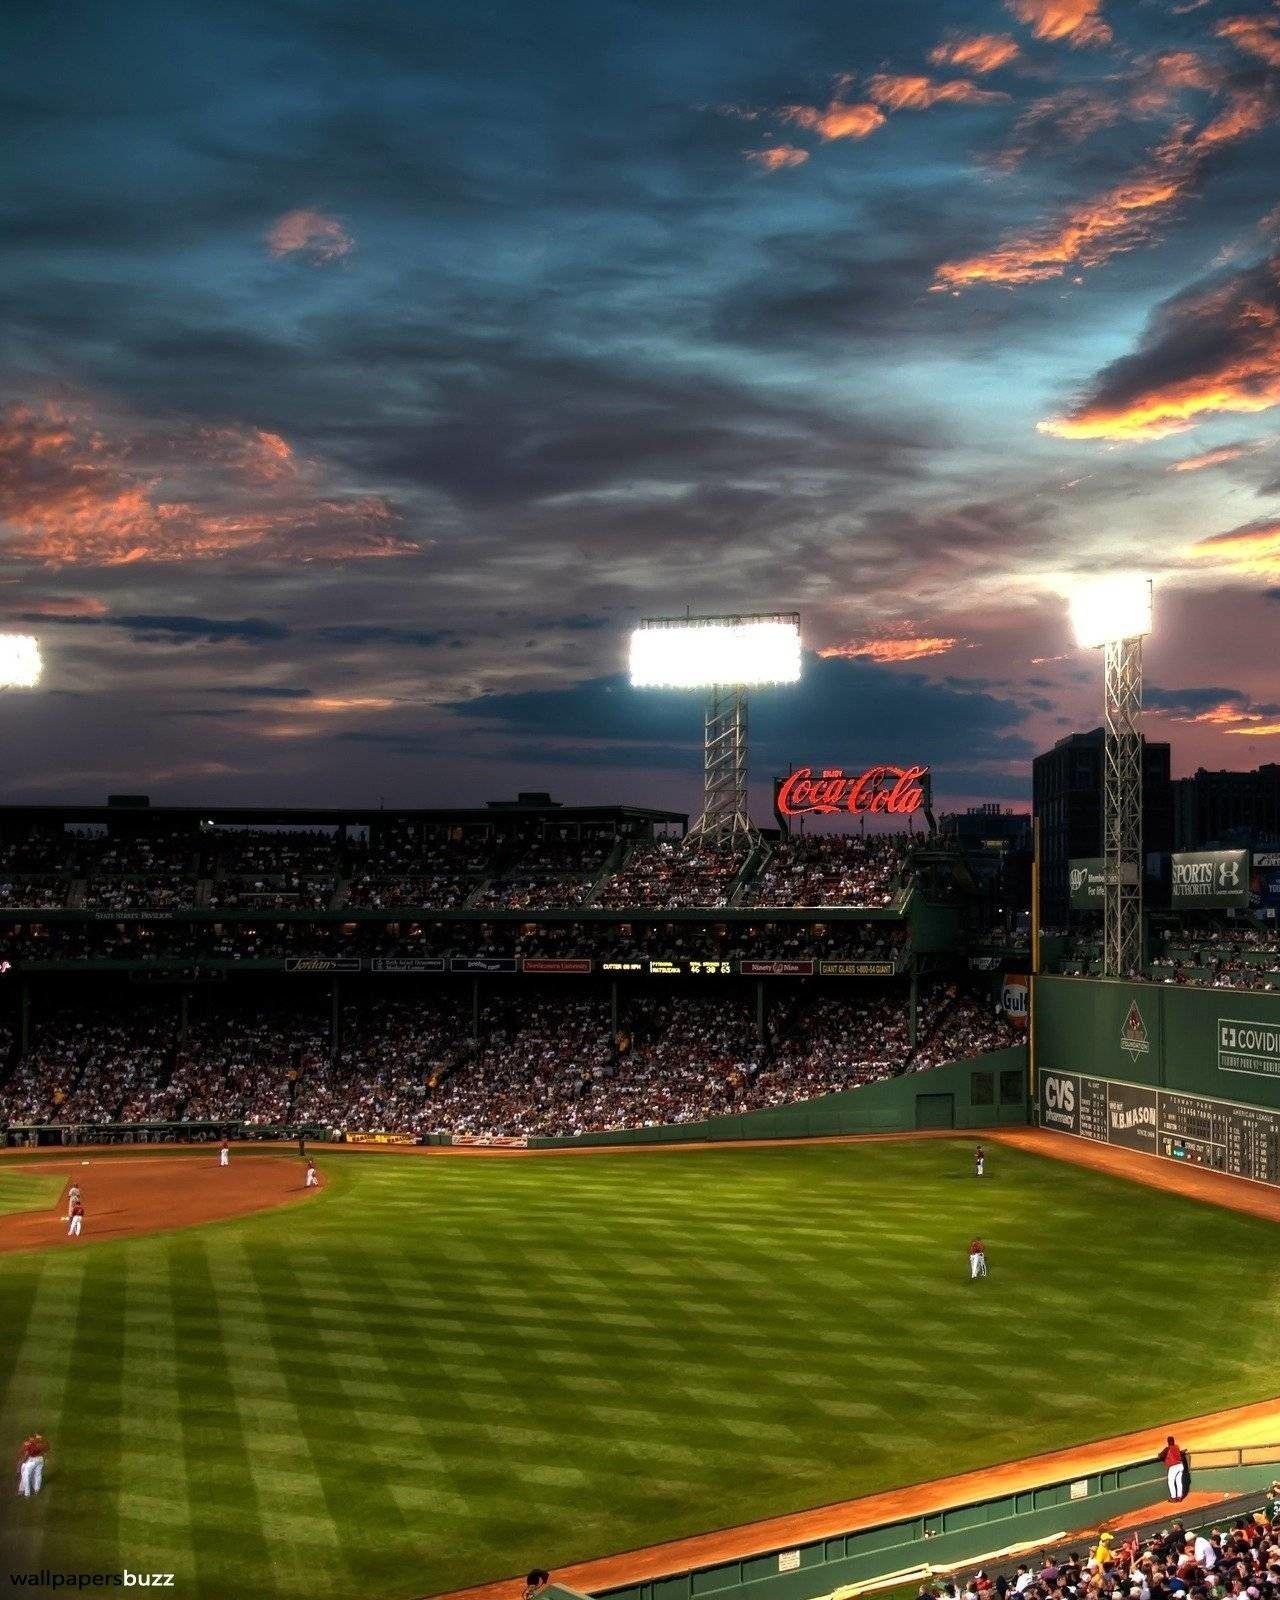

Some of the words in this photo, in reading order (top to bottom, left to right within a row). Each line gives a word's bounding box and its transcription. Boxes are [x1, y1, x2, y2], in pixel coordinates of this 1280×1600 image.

[777, 765, 929, 815] Coca-Cola
[1172, 862, 1213, 883] SPORTS
[1172, 883, 1212, 896] AUTHORITY
[1045, 1076, 1074, 1112] CVS
